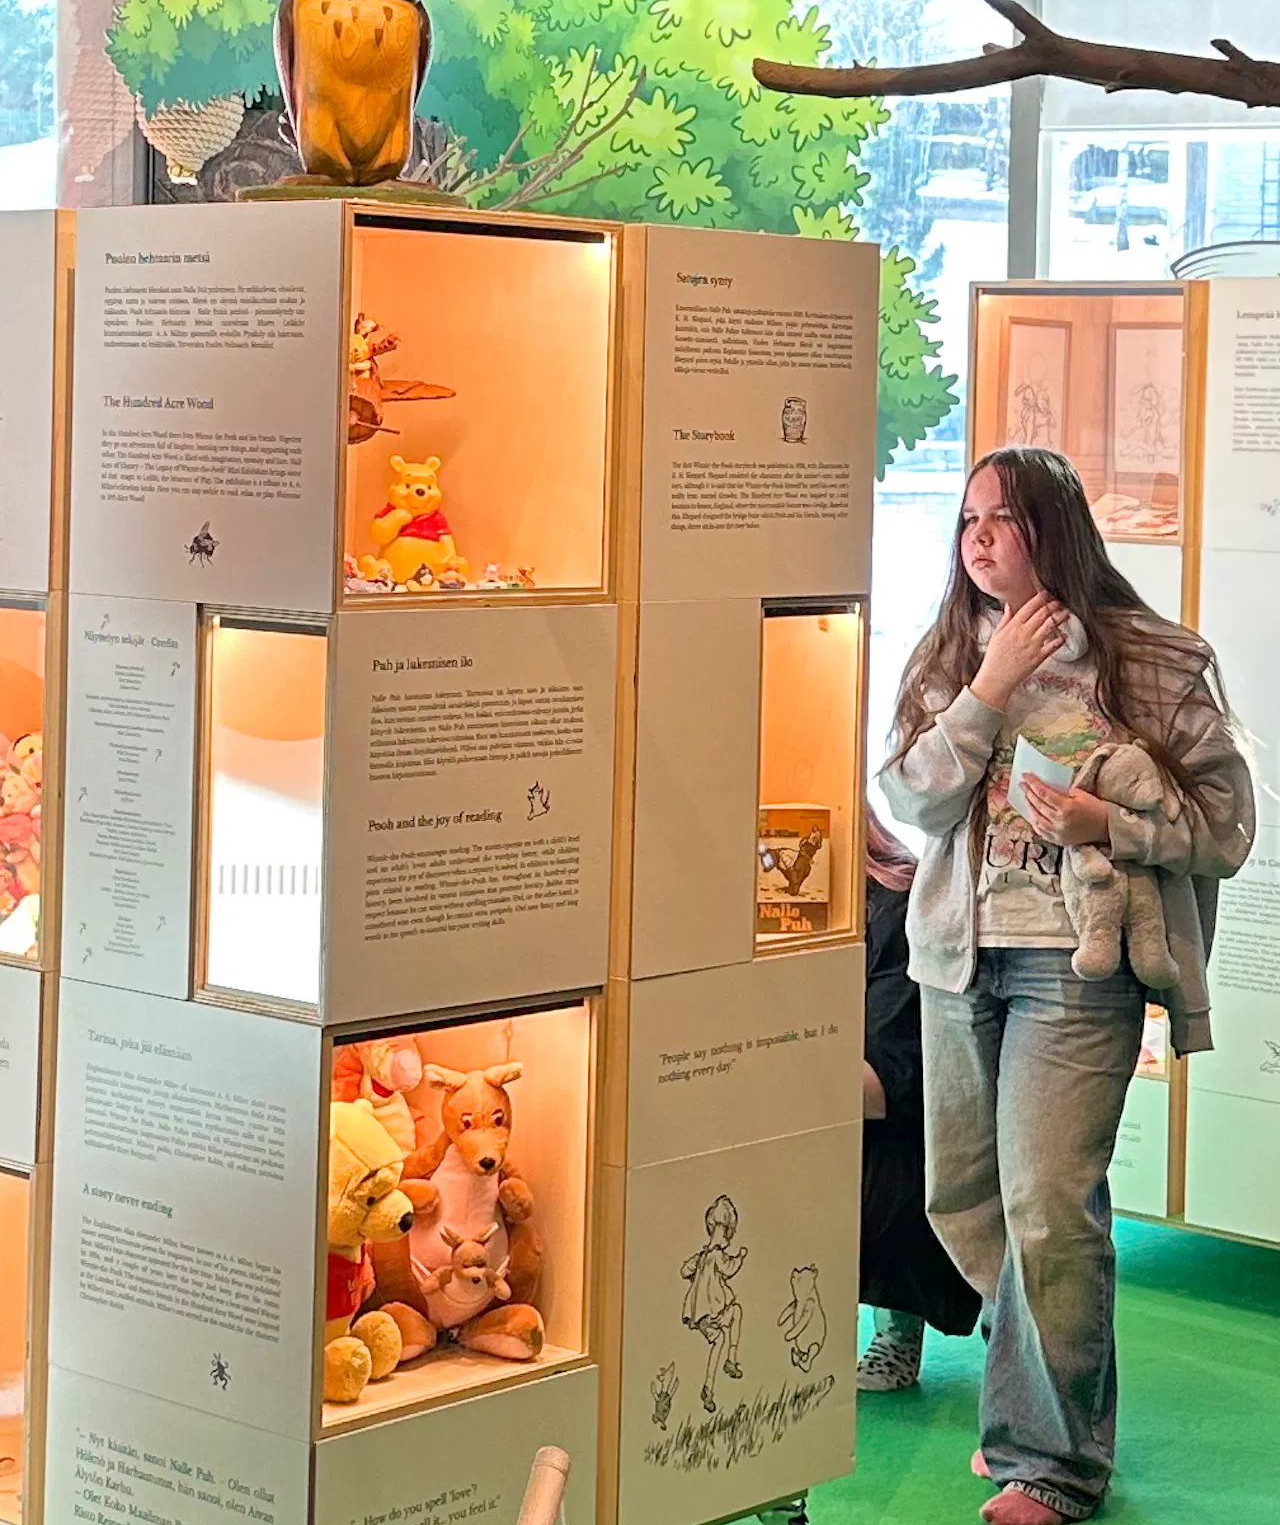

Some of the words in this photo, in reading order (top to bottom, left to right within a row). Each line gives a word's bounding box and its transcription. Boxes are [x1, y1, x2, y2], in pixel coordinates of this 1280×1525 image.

[103, 395, 120, 408] The
[122, 395, 162, 409] Hundred
[164, 397, 184, 410] Acre
[186, 397, 214, 410] Wood
[673, 428, 690, 441] The
[372, 658, 393, 671] Puh
[394, 659, 405, 673] ja
[406, 656, 458, 670] lukemisen
[460, 655, 473, 668] ilo
[368, 818, 394, 831] Pooh
[396, 816, 416, 829] and
[417, 814, 434, 827] the
[434, 814, 450, 829] joy
[452, 810, 465, 824] of
[465, 808, 503, 824] reading
[779, 917, 813, 932] Puh
[693, 1050, 707, 1061] say
[710, 1041, 743, 1056] nothing
[746, 1039, 753, 1050] is
[804, 1028, 818, 1039] but
[827, 1024, 838, 1035] do
[658, 1069, 691, 1083] nothing
[692, 1065, 715, 1077] every
[83, 1183, 89, 1194] A
[91, 1187, 113, 1202] story
[115, 1194, 140, 1208] never
[141, 1200, 173, 1219] ending
[89, 1431, 105, 1448] Nyt
[143, 1452, 166, 1468] sanoi
[170, 1458, 193, 1475] Nalle
[228, 1477, 250, 1495] Olen
[253, 1486, 275, 1505] ollut
[83, 1489, 101, 1504] Olet
[104, 1495, 126, 1513] Koko
[107, 1459, 115, 1472] ja
[178, 1480, 195, 1496] hän
[225, 1498, 246, 1515] olen
[248, 1506, 274, 1525] Aivan
[74, 1504, 96, 1522] Risto
[388, 1507, 402, 1521] do
[403, 1503, 422, 1520] you
[425, 1492, 448, 1513] spell
[448, 1509, 467, 1525] you
[468, 1500, 487, 1516] feel
